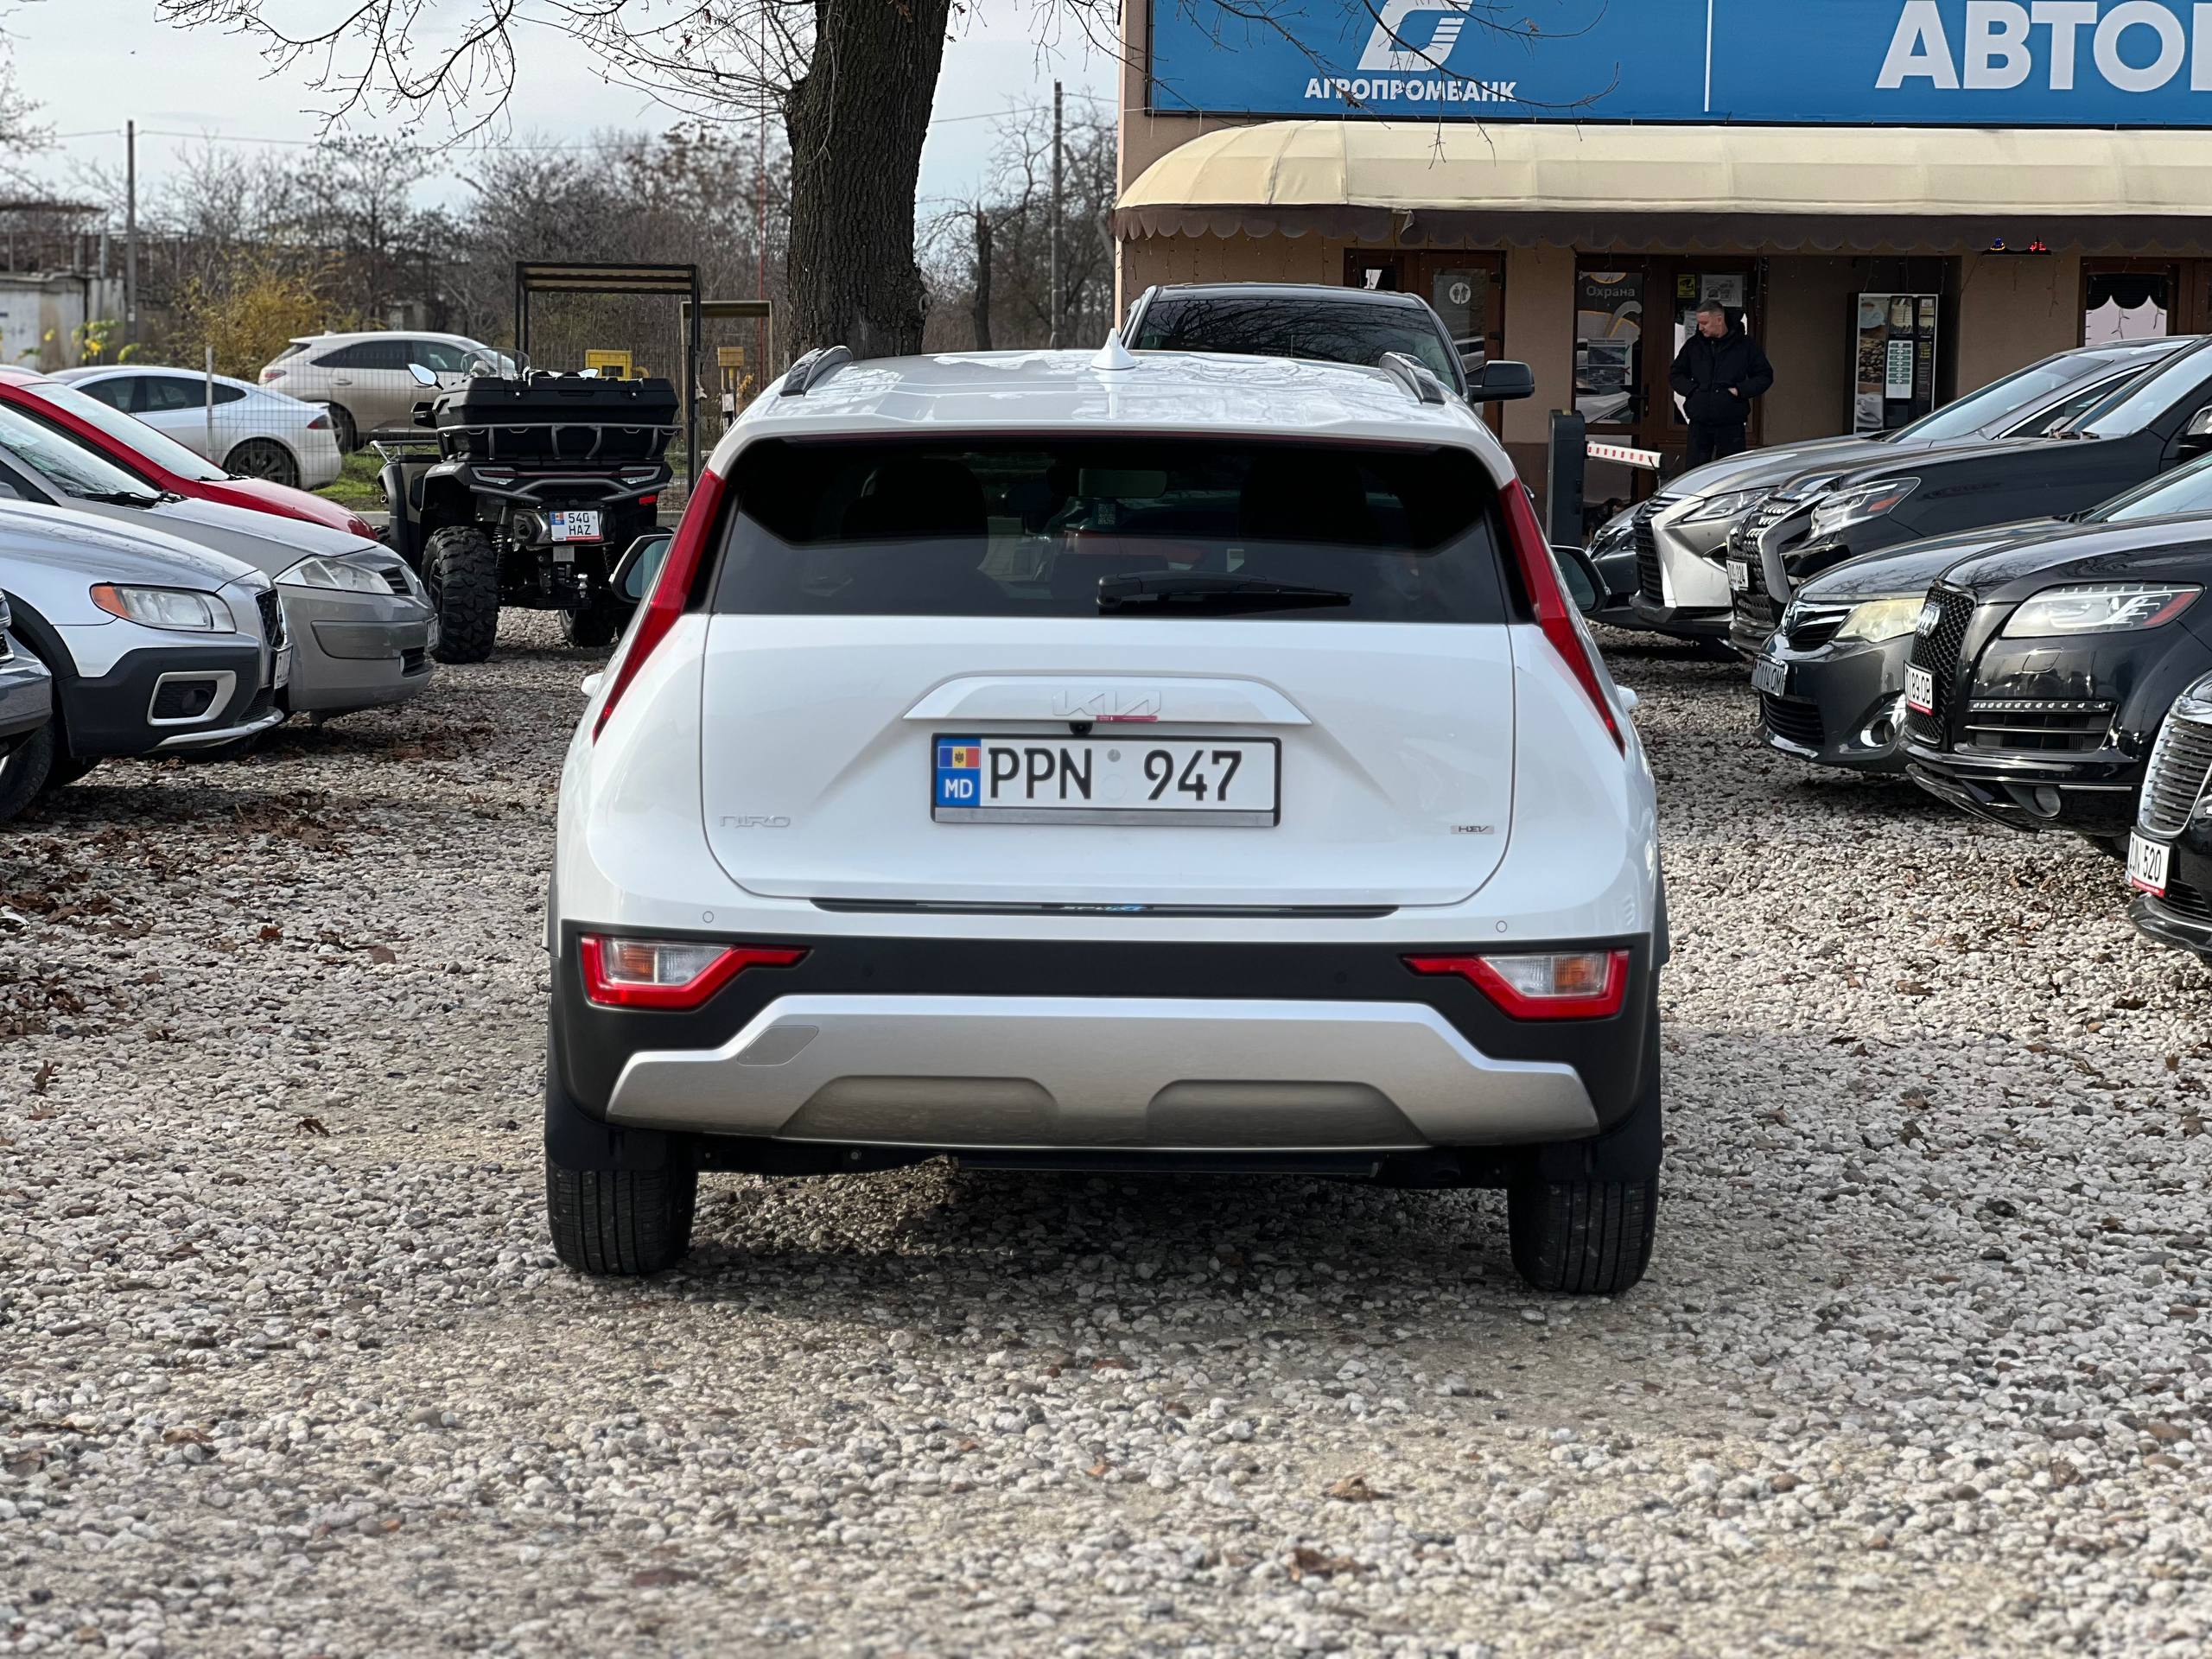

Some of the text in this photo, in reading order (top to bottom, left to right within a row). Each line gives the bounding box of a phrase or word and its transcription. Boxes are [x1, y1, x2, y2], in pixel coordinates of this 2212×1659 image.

[1874, 0, 2212, 92] АВТО
[1304, 77, 1518, 103] АГРОПРОМБАНК
[1586, 285, 1636, 300] Охрана
[568, 512, 589, 524] 540
[569, 524, 592, 536] HAZ
[1052, 690, 1161, 717] KIA
[988, 747, 1243, 802] PPN 947
[944, 779, 973, 799] MD
[2143, 844, 2162, 882] 520
